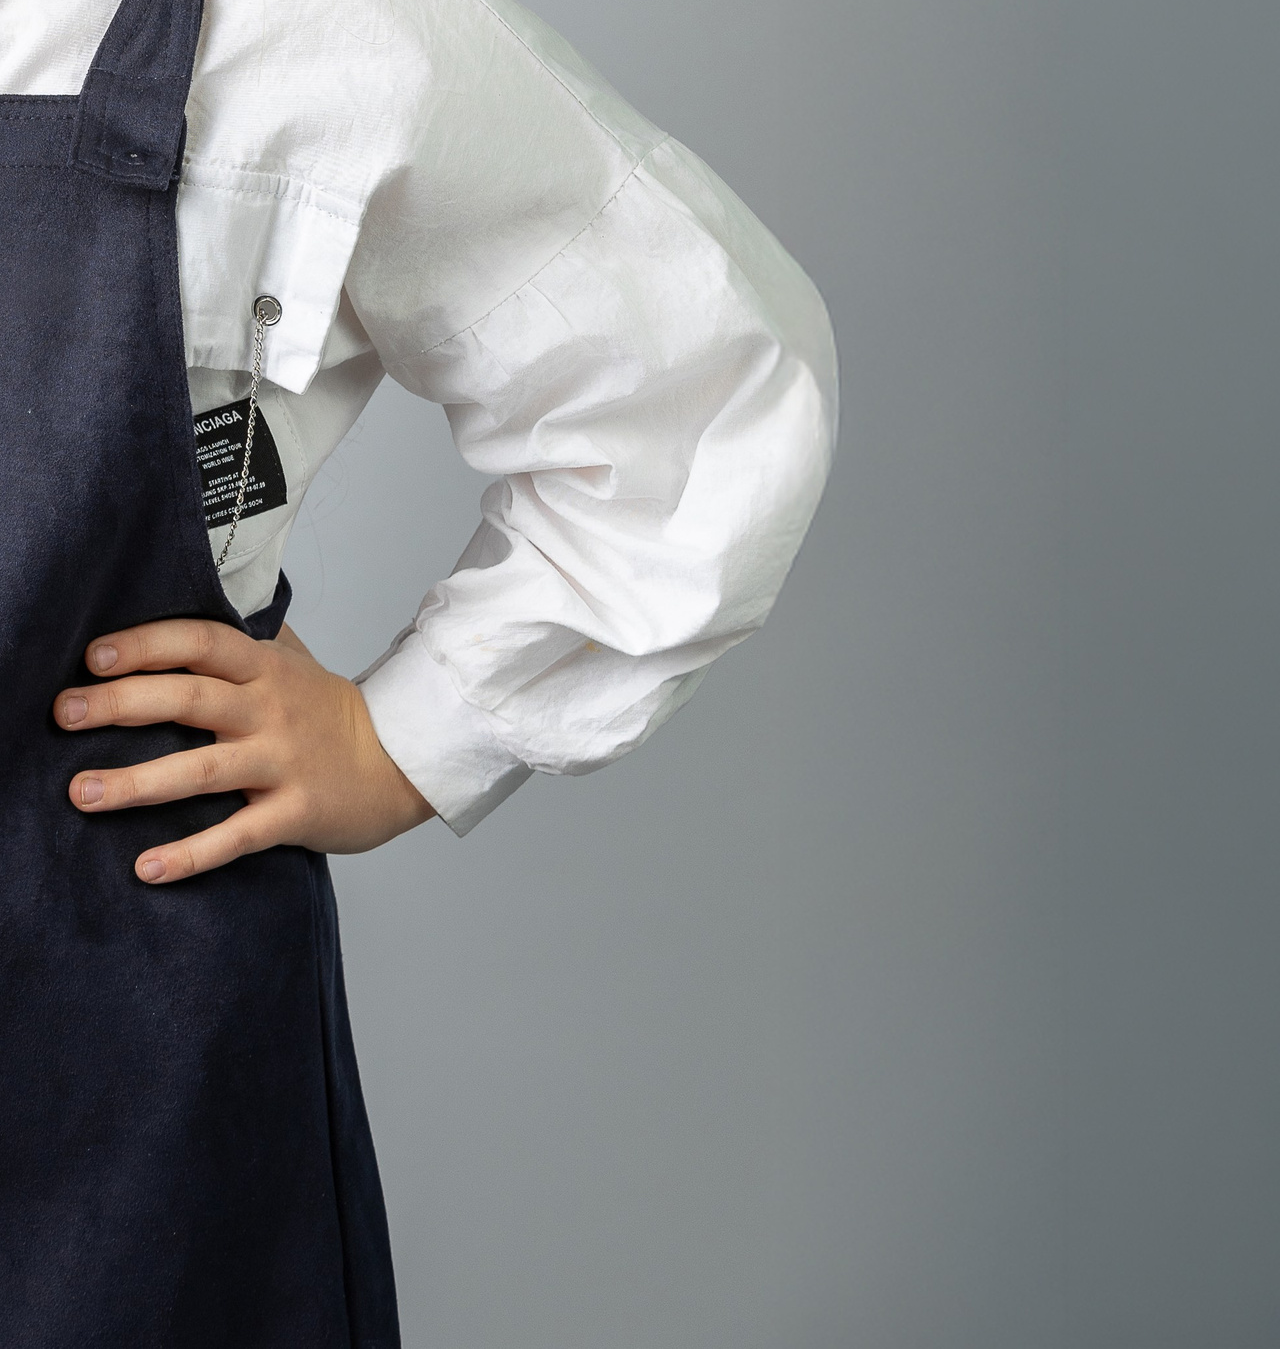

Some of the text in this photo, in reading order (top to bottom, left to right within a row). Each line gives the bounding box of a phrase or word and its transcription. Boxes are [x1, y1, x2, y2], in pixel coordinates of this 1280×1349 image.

[193, 410, 243, 436] NCIAGA
[208, 438, 230, 450] LAUNCH
[228, 442, 242, 451] TOUR
[202, 454, 235, 470] WORLD WIDE
[208, 471, 239, 487] STARTING AT
[221, 490, 238, 501] SHOES
[228, 502, 248, 514] CONG
[248, 498, 263, 508] SOON
